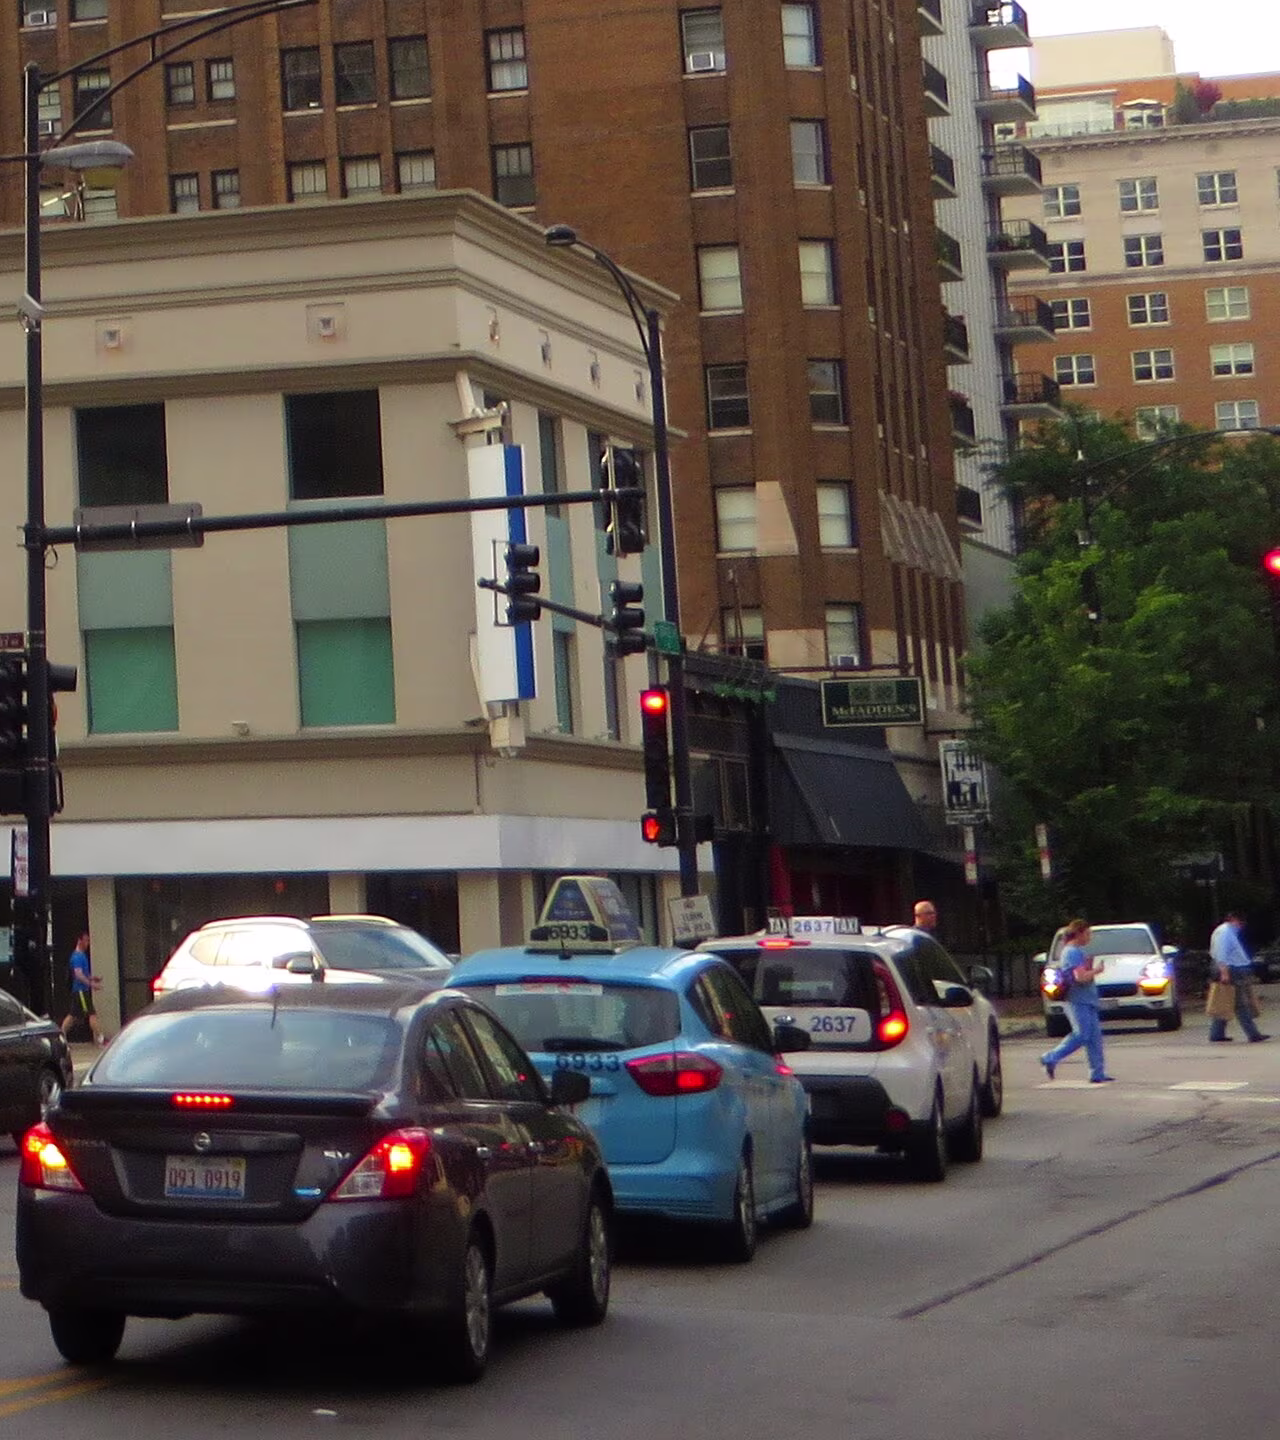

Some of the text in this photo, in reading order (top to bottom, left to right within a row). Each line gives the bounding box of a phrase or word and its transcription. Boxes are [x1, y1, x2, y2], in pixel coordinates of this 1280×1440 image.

[549, 924, 590, 940] 6933
[794, 920, 832, 933] 2637
[811, 1015, 856, 1033] 2637
[556, 1053, 620, 1072] 6933
